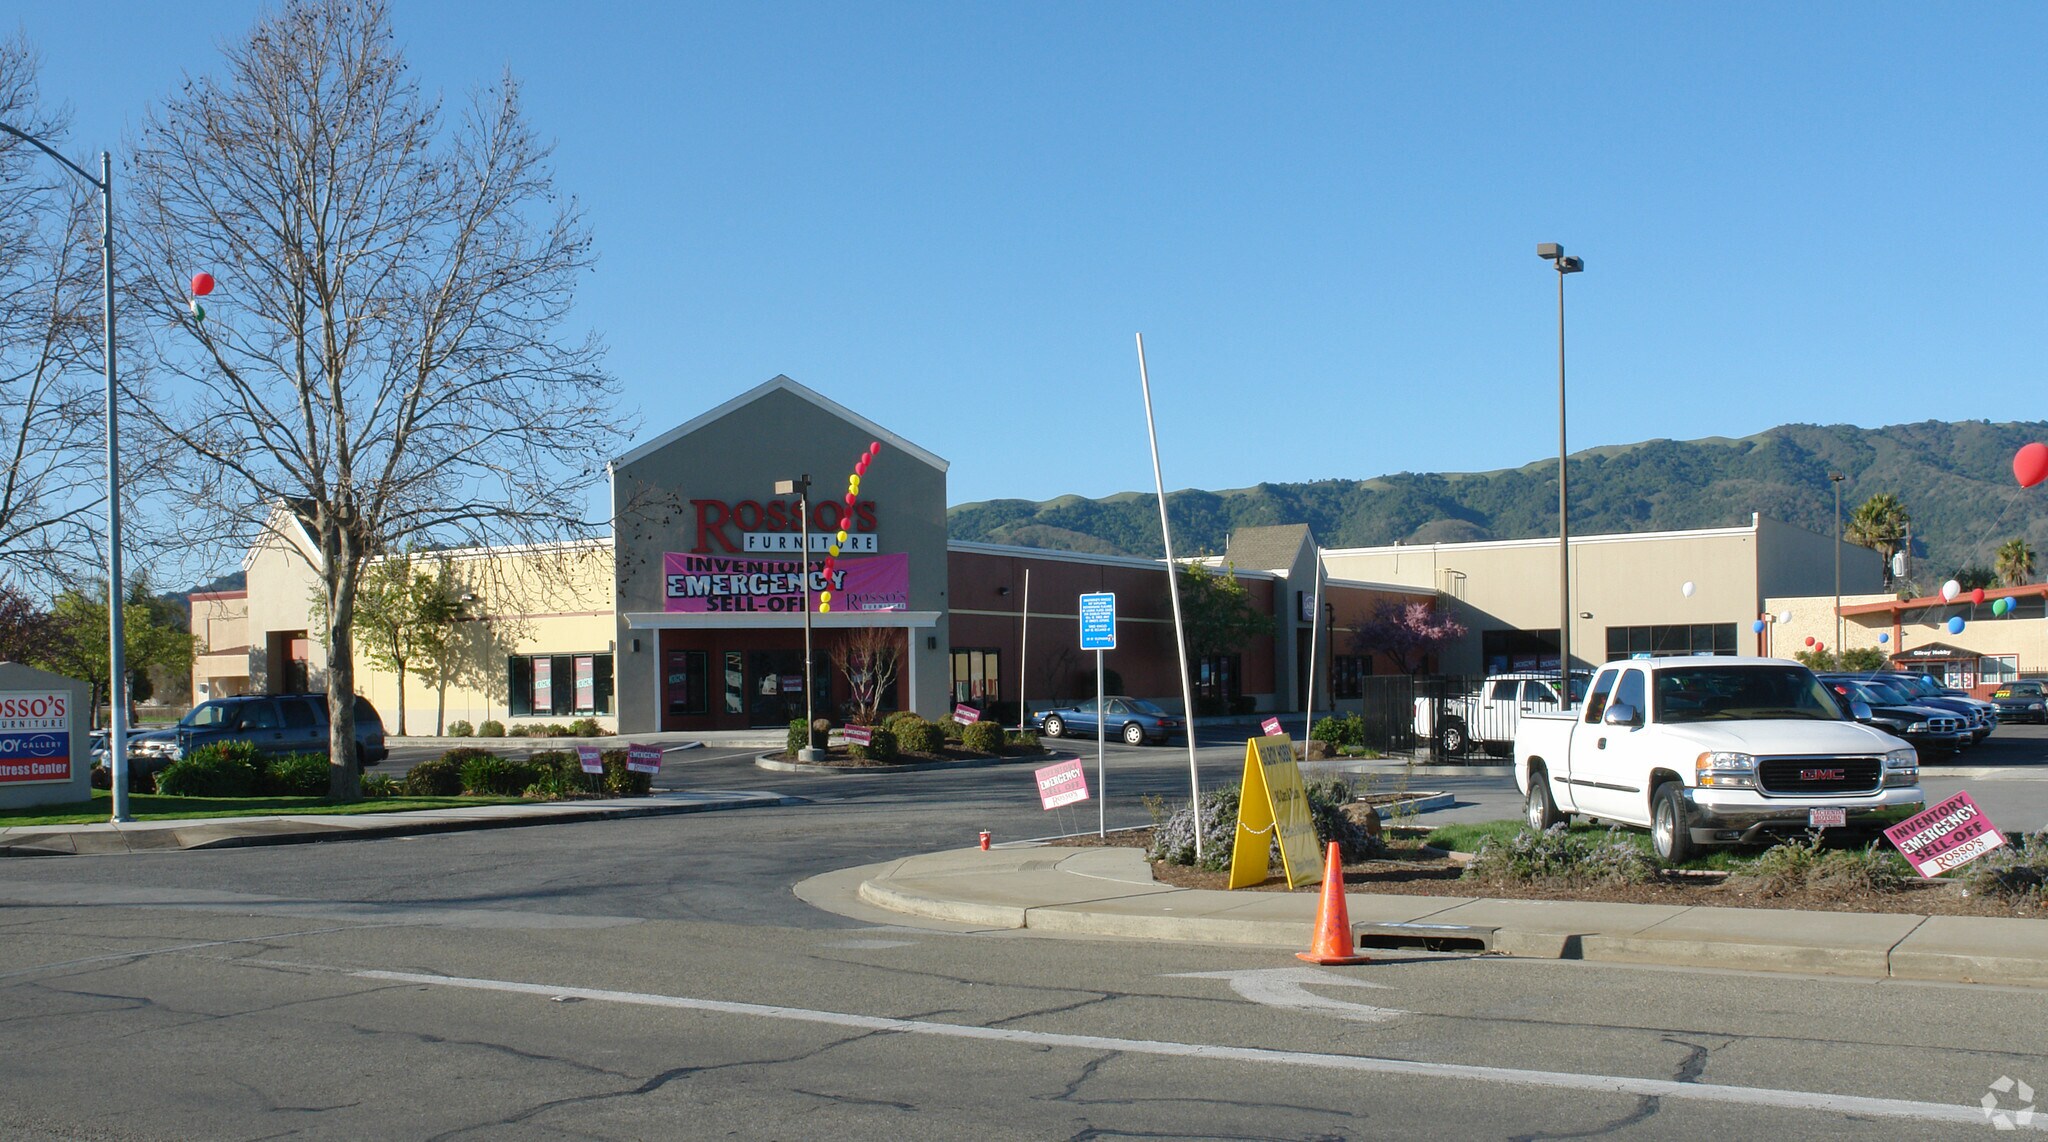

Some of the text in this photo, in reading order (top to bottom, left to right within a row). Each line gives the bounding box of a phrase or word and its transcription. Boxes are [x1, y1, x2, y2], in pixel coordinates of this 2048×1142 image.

[690, 499, 877, 553] ROSSOS
[749, 536, 872, 549] FURNITURE
[667, 569, 848, 598] EMERGENCY
[0, 695, 65, 717] SSO'S
[32, 762, 67, 774] Center
[1039, 767, 1080, 790] EMERGENCY
[1800, 769, 1845, 780] GMC
[1892, 796, 1967, 839] INVENTORY
[1899, 804, 1979, 854] EMERGENCY
[1914, 821, 1982, 860] SELL-OFF
[1933, 838, 1984, 871] ROSSO'S
